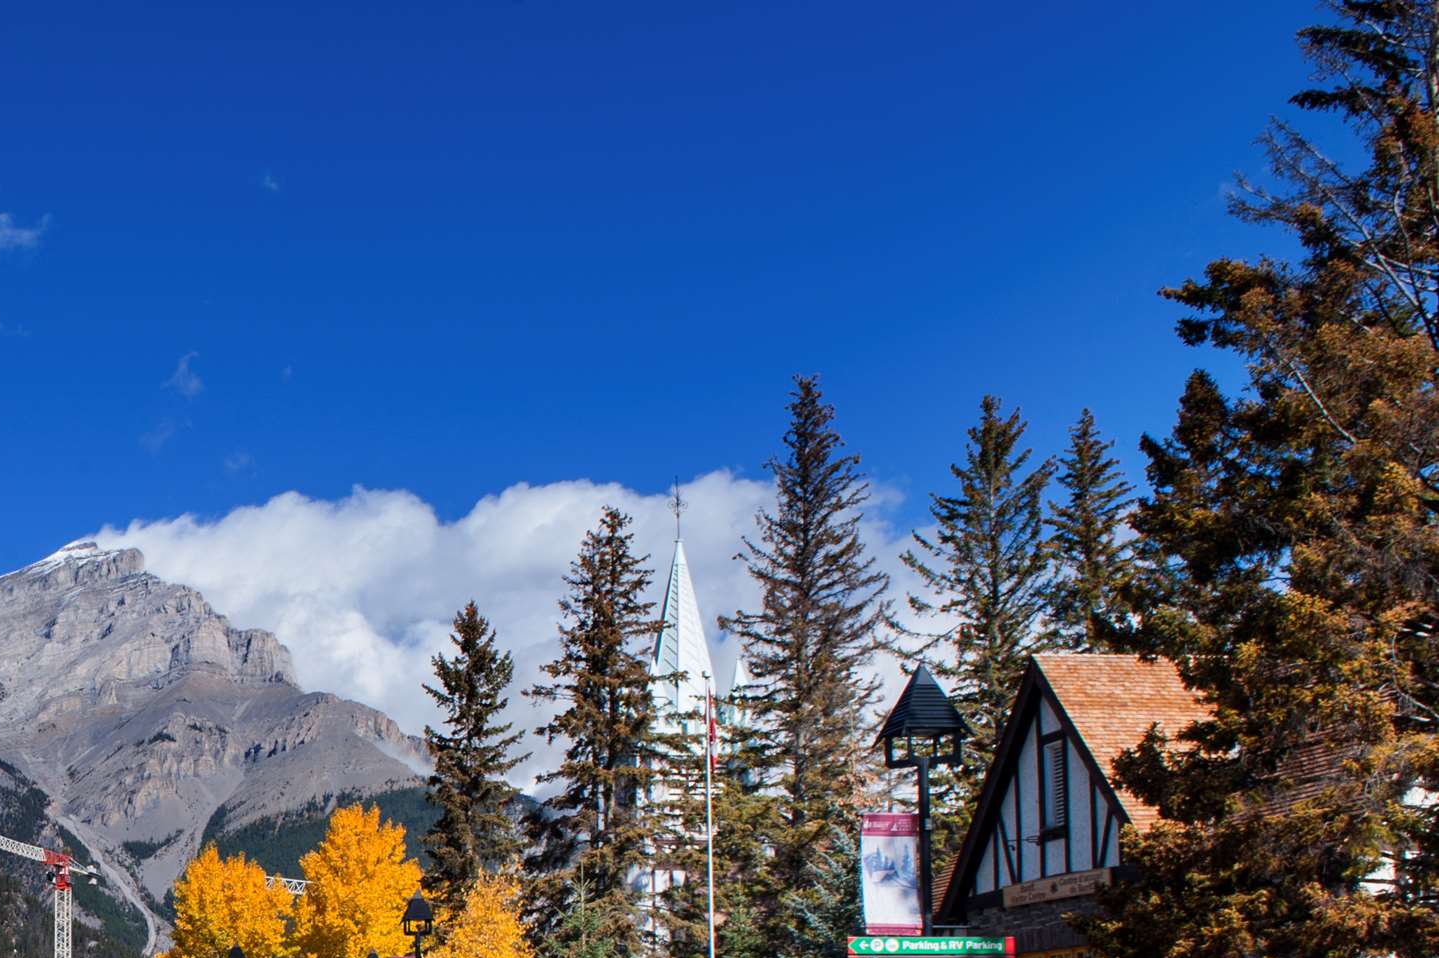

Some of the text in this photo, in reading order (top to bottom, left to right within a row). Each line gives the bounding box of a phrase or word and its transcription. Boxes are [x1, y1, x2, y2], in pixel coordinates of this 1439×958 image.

[902, 940, 940, 952] Parking
[948, 941, 964, 950] RV
[965, 940, 1003, 951] Parking
